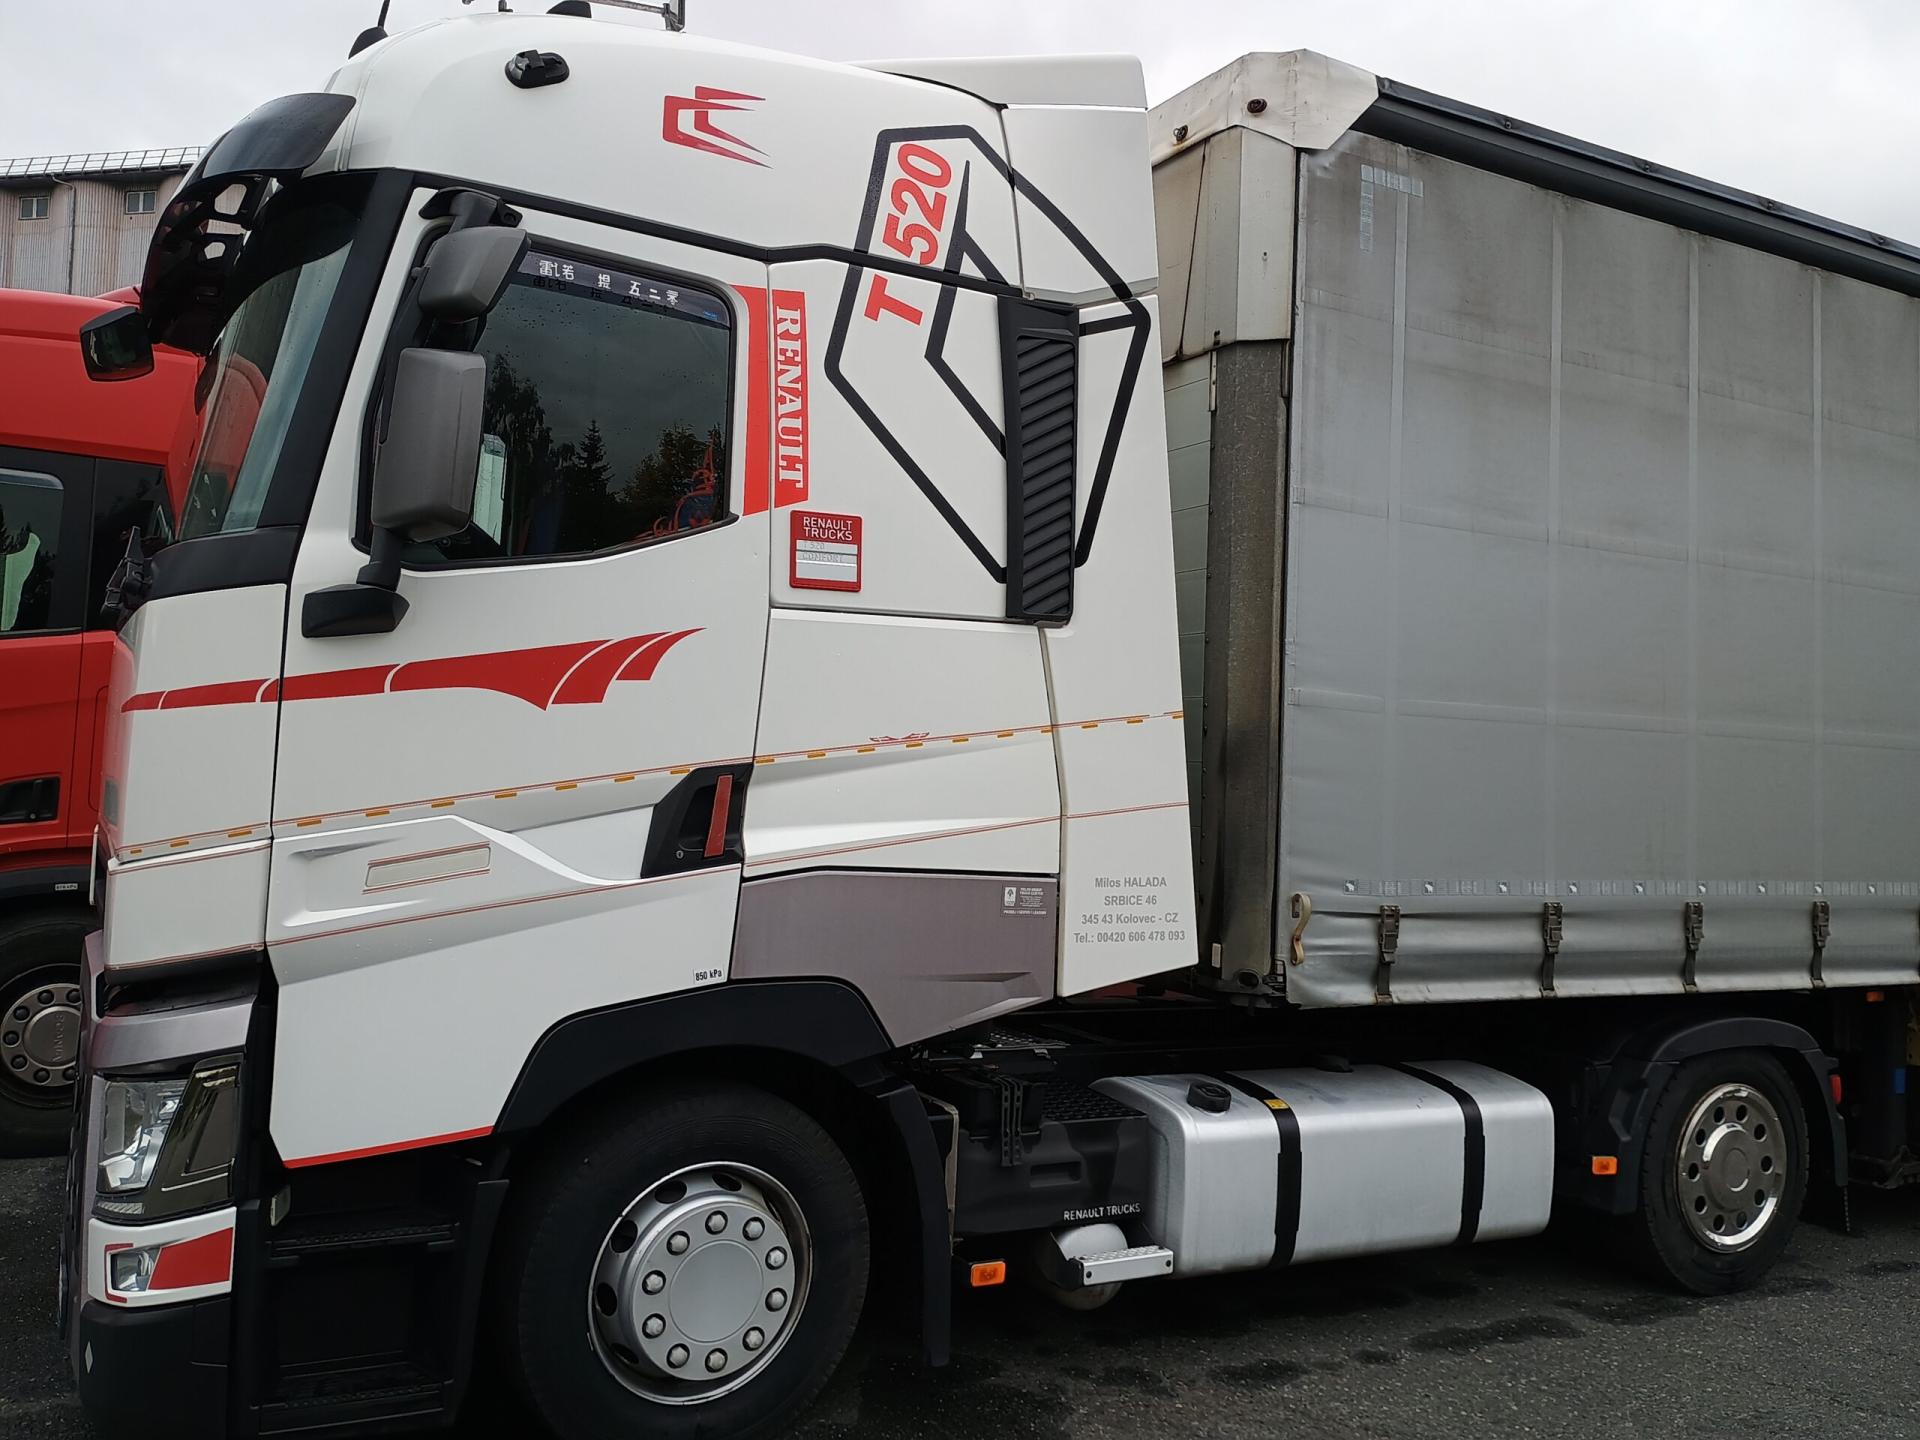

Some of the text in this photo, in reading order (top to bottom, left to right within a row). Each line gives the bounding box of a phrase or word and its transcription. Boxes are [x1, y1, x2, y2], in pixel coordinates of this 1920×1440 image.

[864, 143, 952, 326] T 520
[776, 305, 804, 489] RENAULT
[803, 516, 853, 530] RENAULT
[803, 527, 853, 540] TRUCKS
[1095, 876, 1167, 888] Milos HALADA
[1104, 895, 1157, 906] SRBICE 46
[1081, 914, 1099, 925] 345
[1101, 914, 1113, 924] 43
[1116, 913, 1156, 924] Kolovec
[1164, 912, 1179, 923] CZ
[1073, 930, 1186, 943] Tel.: 00420 606 478 093
[695, 969, 722, 981] 850 kPa
[1063, 1203, 1140, 1220] RENAULT TRUCKS
